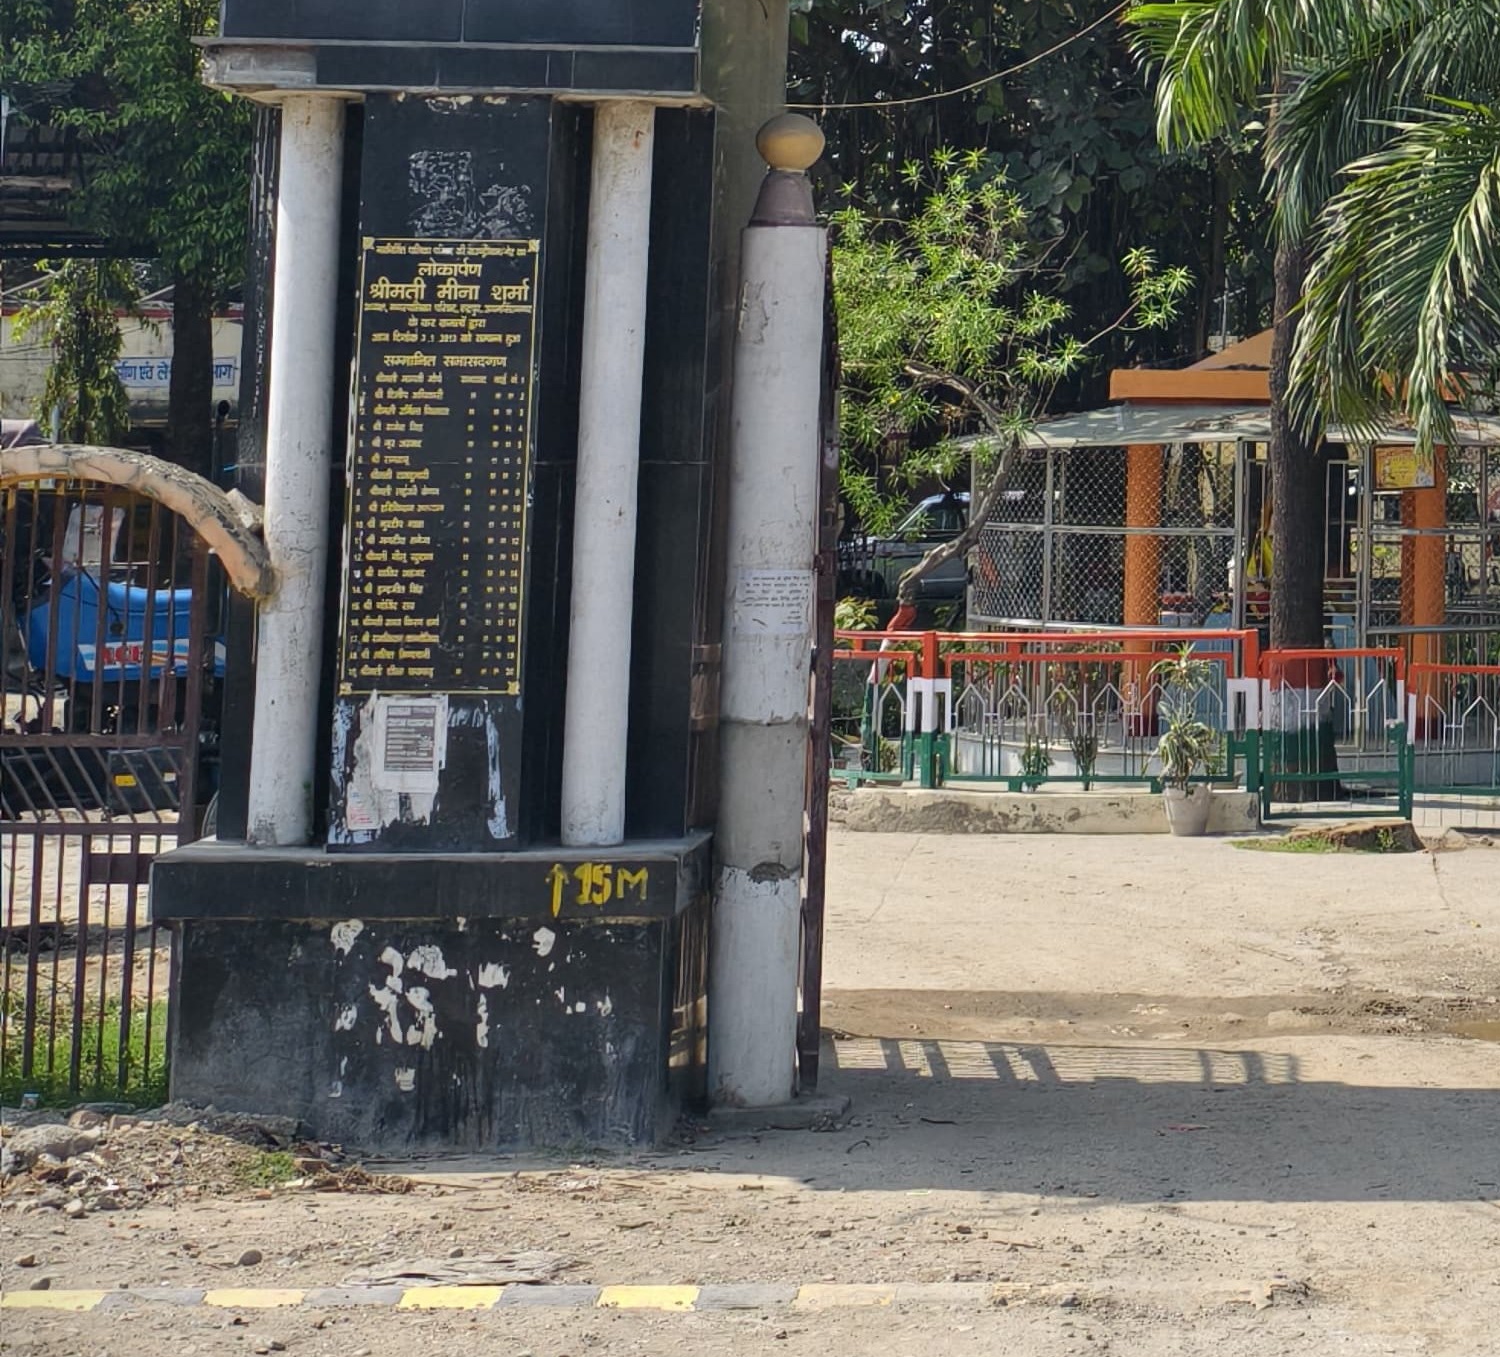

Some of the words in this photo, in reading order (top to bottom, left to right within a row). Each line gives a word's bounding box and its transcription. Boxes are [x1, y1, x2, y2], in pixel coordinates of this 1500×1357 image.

[417, 257, 482, 277] लोकार्पण
[370, 276, 426, 301] श्रीमती
[437, 276, 480, 300] मीना
[491, 278, 530, 302] शर्मा
[574, 862, 613, 904] 15
